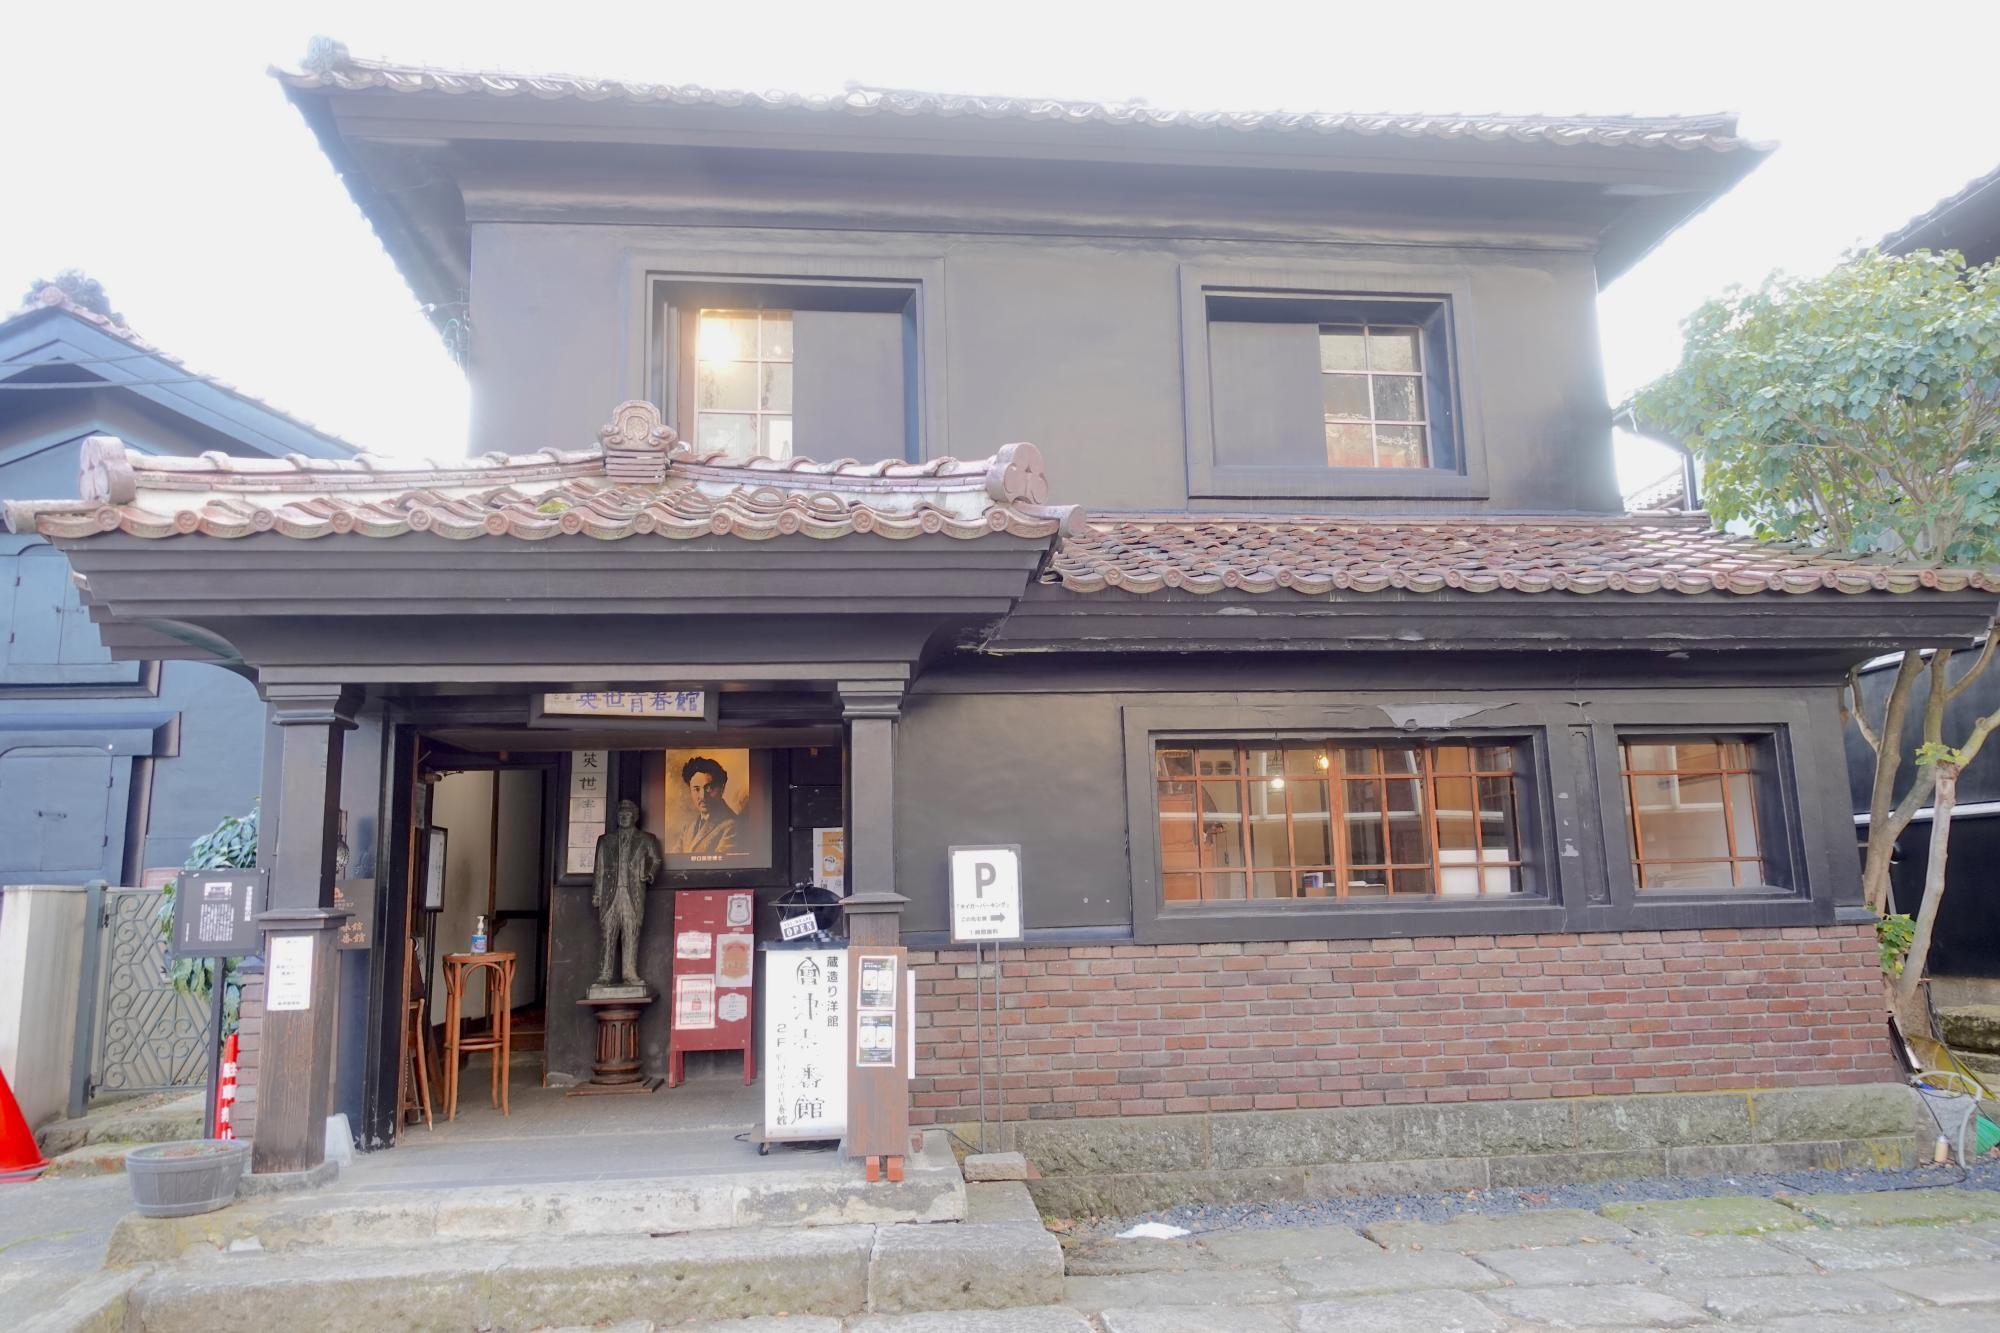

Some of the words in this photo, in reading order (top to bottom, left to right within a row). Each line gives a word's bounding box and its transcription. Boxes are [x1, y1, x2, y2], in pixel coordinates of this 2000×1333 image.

[975, 862, 997, 899] P
[785, 921, 813, 938] OPEN
[826, 956, 839, 1028] 蔵造り洋館
